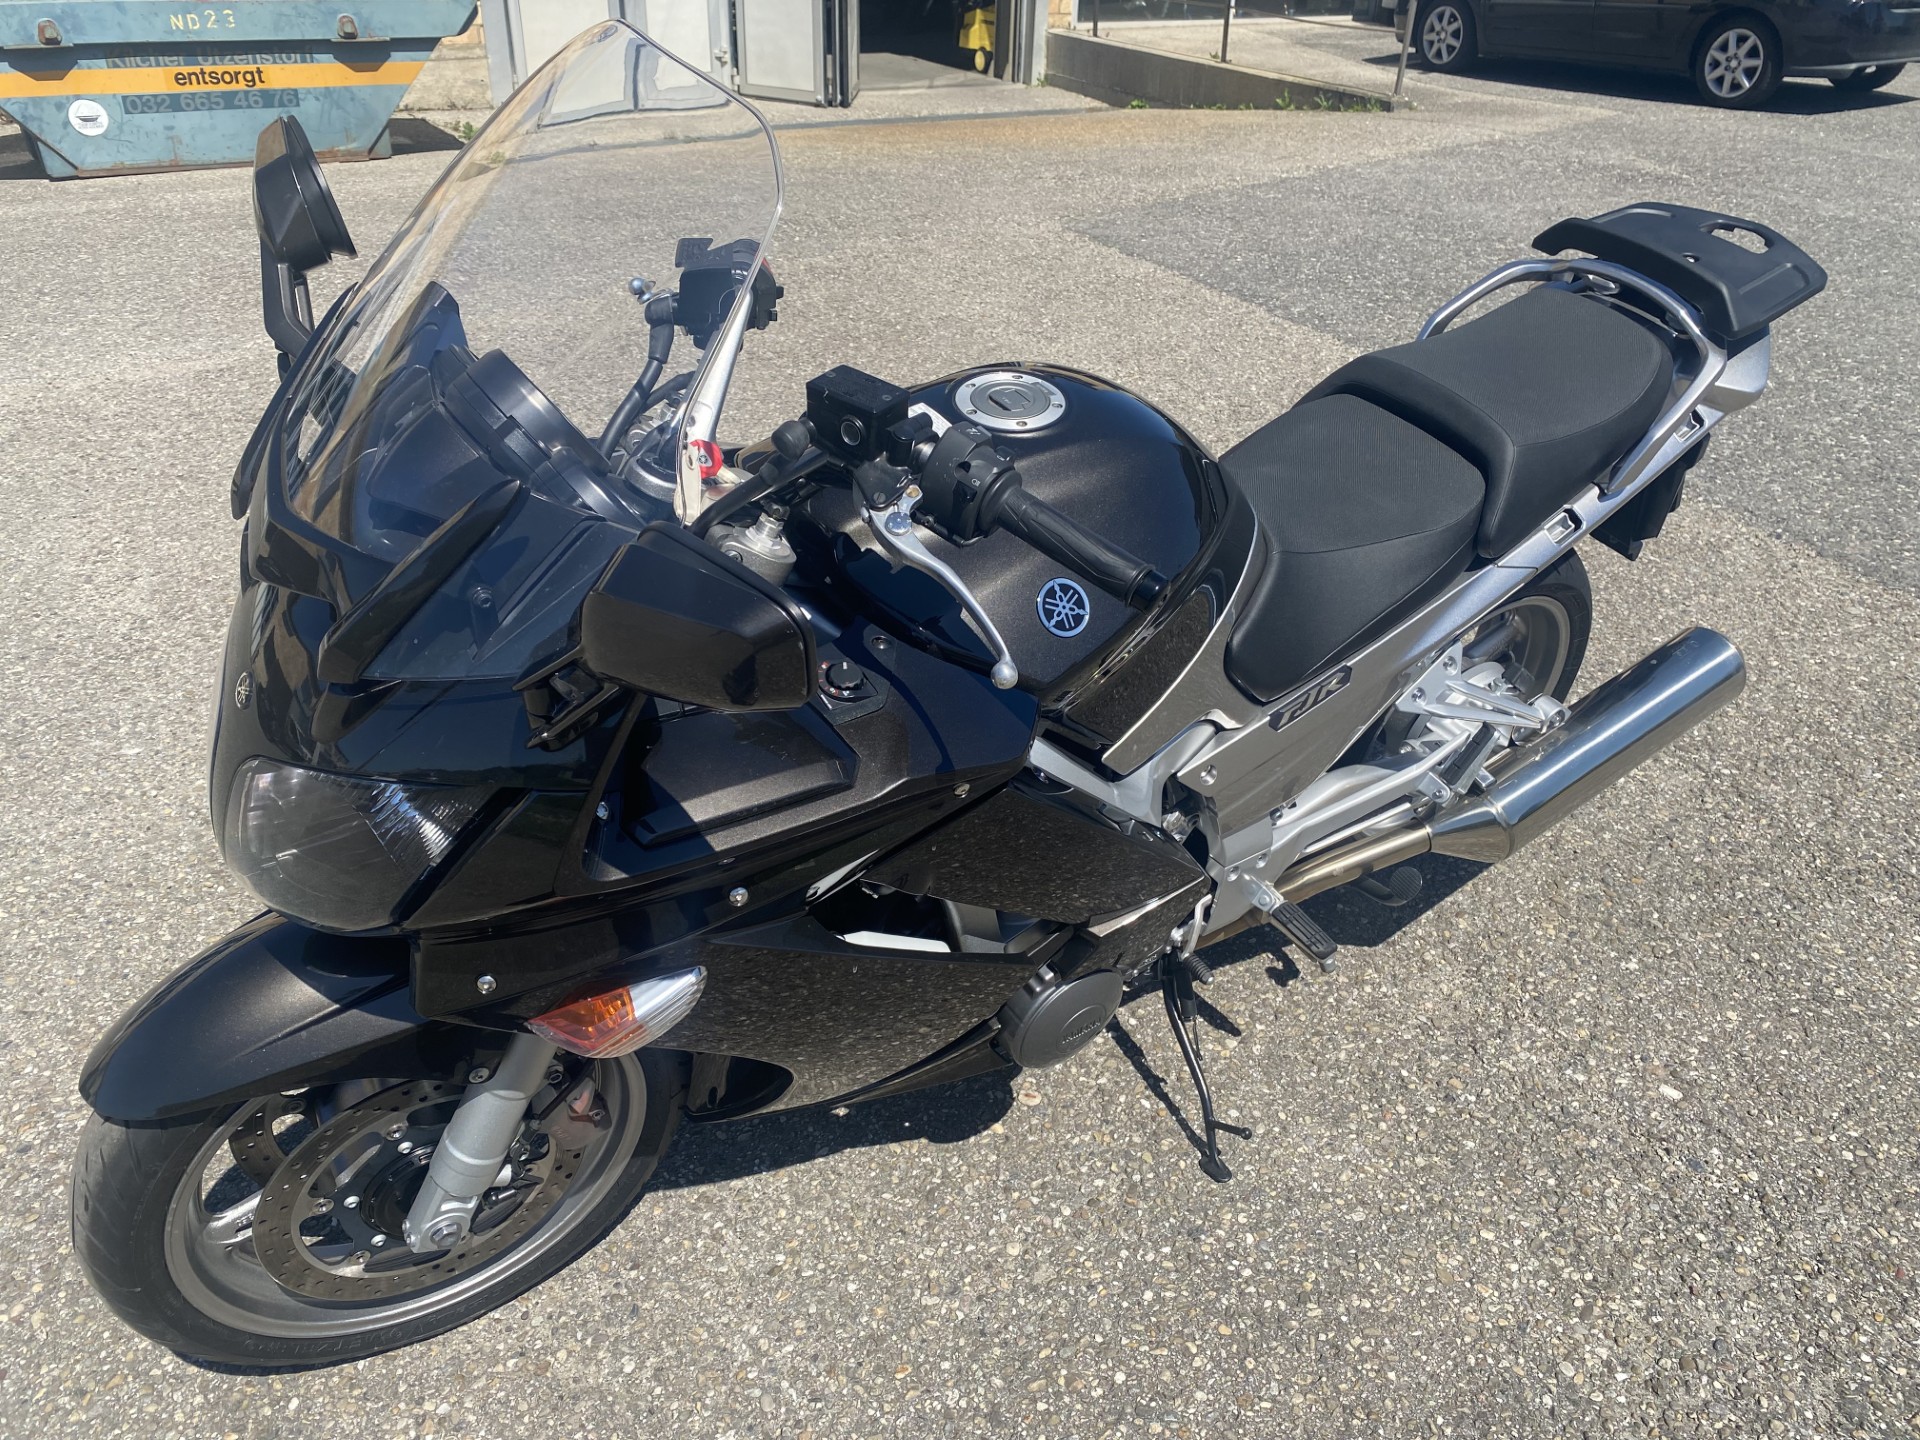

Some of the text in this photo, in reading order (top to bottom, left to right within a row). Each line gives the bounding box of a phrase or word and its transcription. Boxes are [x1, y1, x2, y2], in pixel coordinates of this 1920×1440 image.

[173, 67, 266, 88] entsorgt
[126, 89, 298, 114] 032 665 46 76
[1277, 672, 1346, 729] FJR
